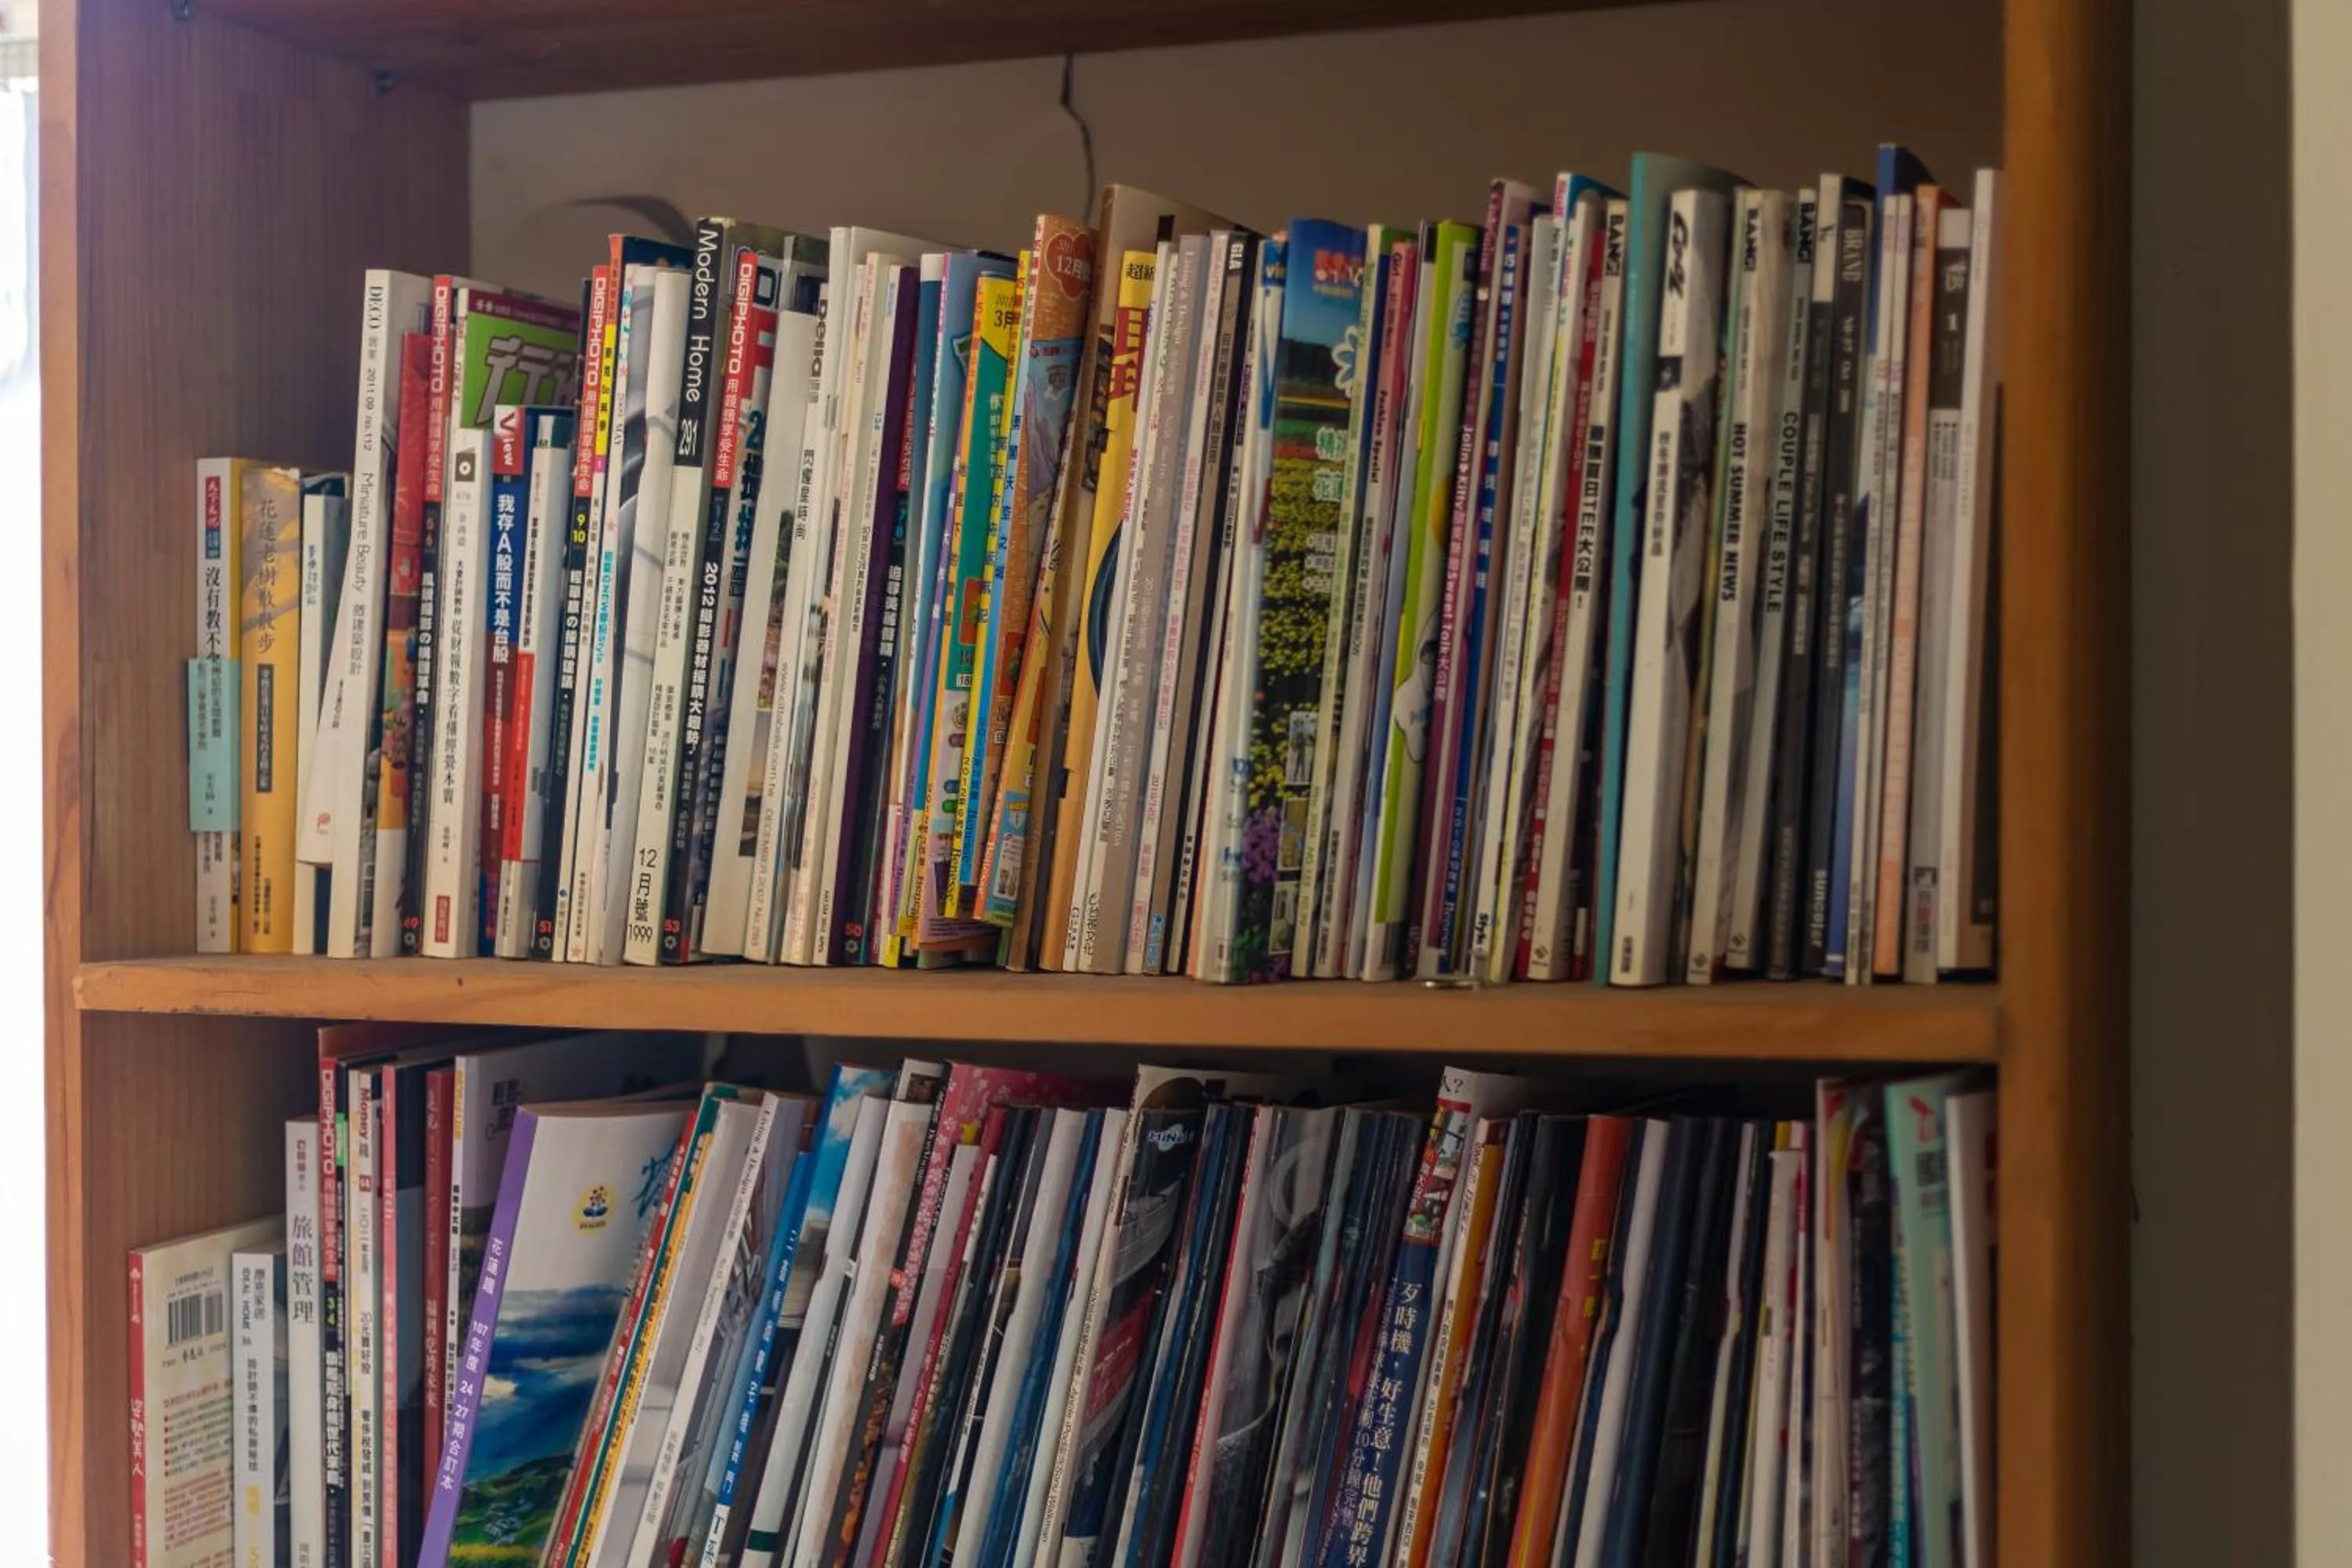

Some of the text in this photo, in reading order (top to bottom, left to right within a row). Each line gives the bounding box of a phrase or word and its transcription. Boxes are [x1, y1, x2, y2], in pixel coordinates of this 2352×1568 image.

[693, 228, 719, 319] Modern
[728, 262, 753, 375] DIGIPHOTO
[430, 285, 448, 393] DIGIPHOTO
[588, 276, 607, 386] DIGIPHOTO
[685, 335, 710, 403] Home
[355, 473, 374, 539] Miniature
[1721, 423, 1748, 603] HOT SUMMER NEWS
[1766, 411, 1798, 614] COUPLE LIFE STYLE
[352, 543, 371, 593] Beauty
[492, 494, 516, 664] 我存A股而不是台股
[321, 1069, 336, 1175] DIGIPHOTO
[358, 1087, 370, 1141] Money
[292, 1214, 314, 1324] 旅館管理
